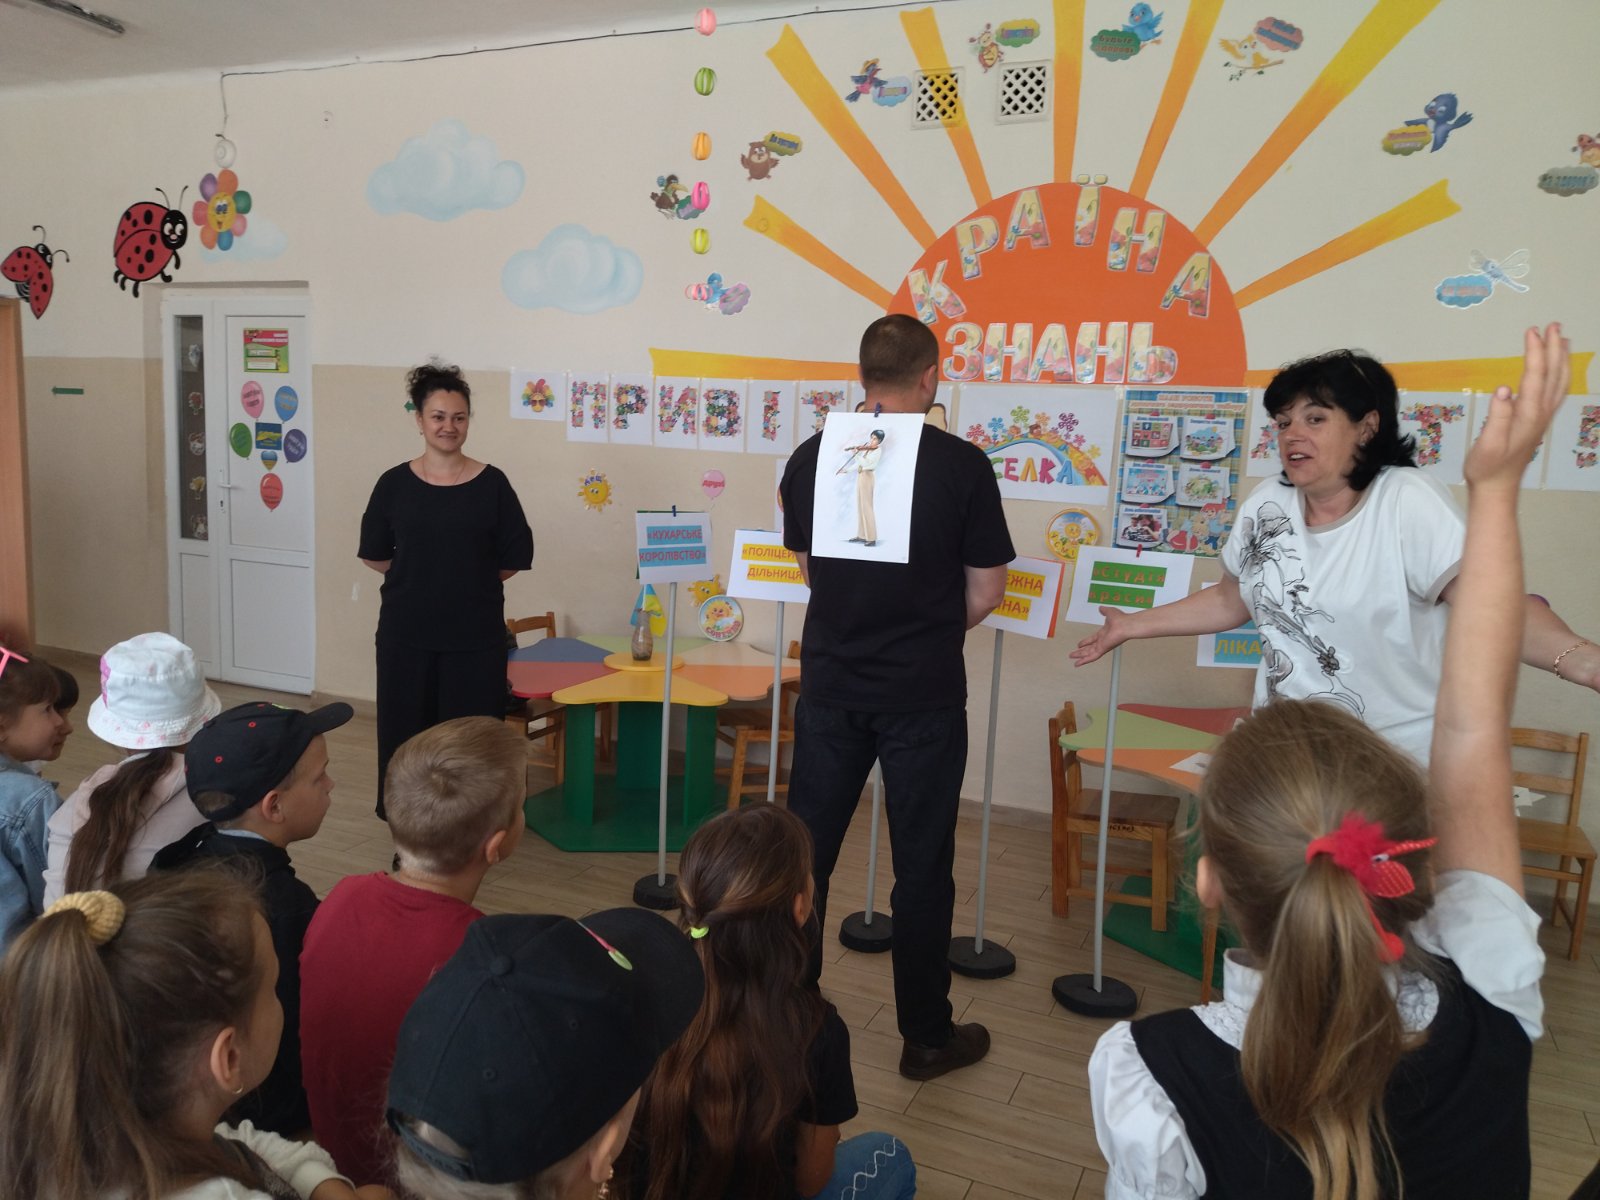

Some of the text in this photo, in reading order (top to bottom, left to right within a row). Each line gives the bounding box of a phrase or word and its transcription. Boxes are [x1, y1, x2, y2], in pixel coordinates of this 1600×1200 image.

[908, 174, 1211, 324] КРАЇНА
[942, 321, 1178, 384] ЗНАНЬ
[990, 457, 1073, 485] СЕЛКА
[1215, 639, 1263, 656] ЛІКА
